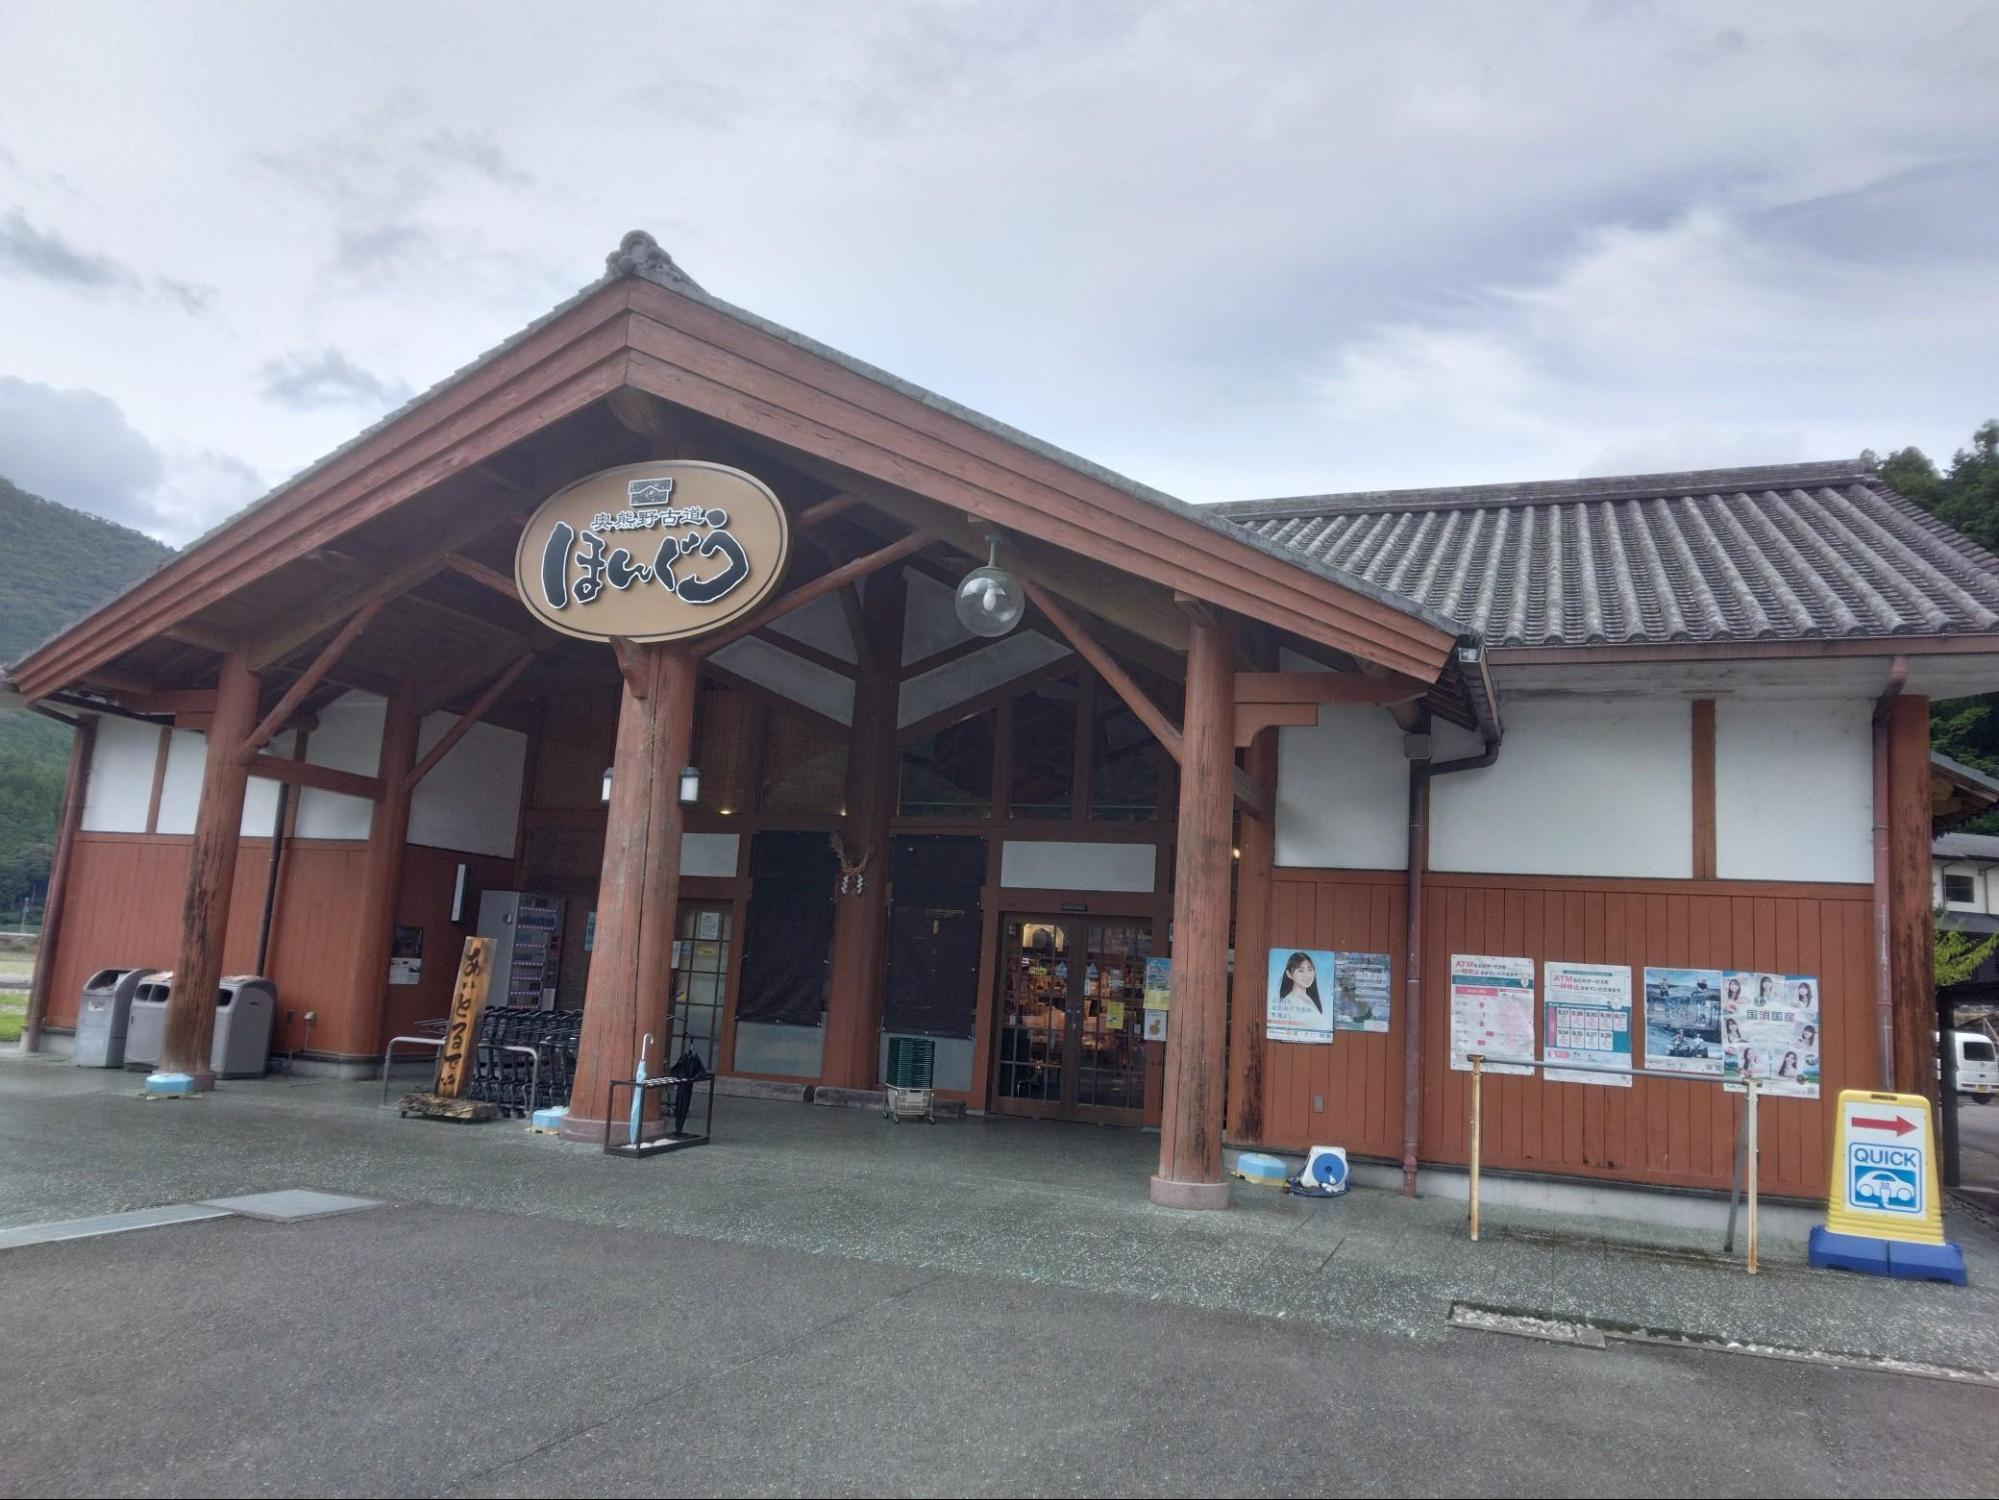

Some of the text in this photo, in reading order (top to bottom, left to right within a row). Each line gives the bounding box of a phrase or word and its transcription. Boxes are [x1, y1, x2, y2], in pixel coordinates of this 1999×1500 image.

[591, 507, 705, 531] 奥熊野古道
[541, 508, 748, 609] ほんぐう
[1746, 1009, 1796, 1023] 国消国産
[1854, 1147, 1917, 1168] QUICK
